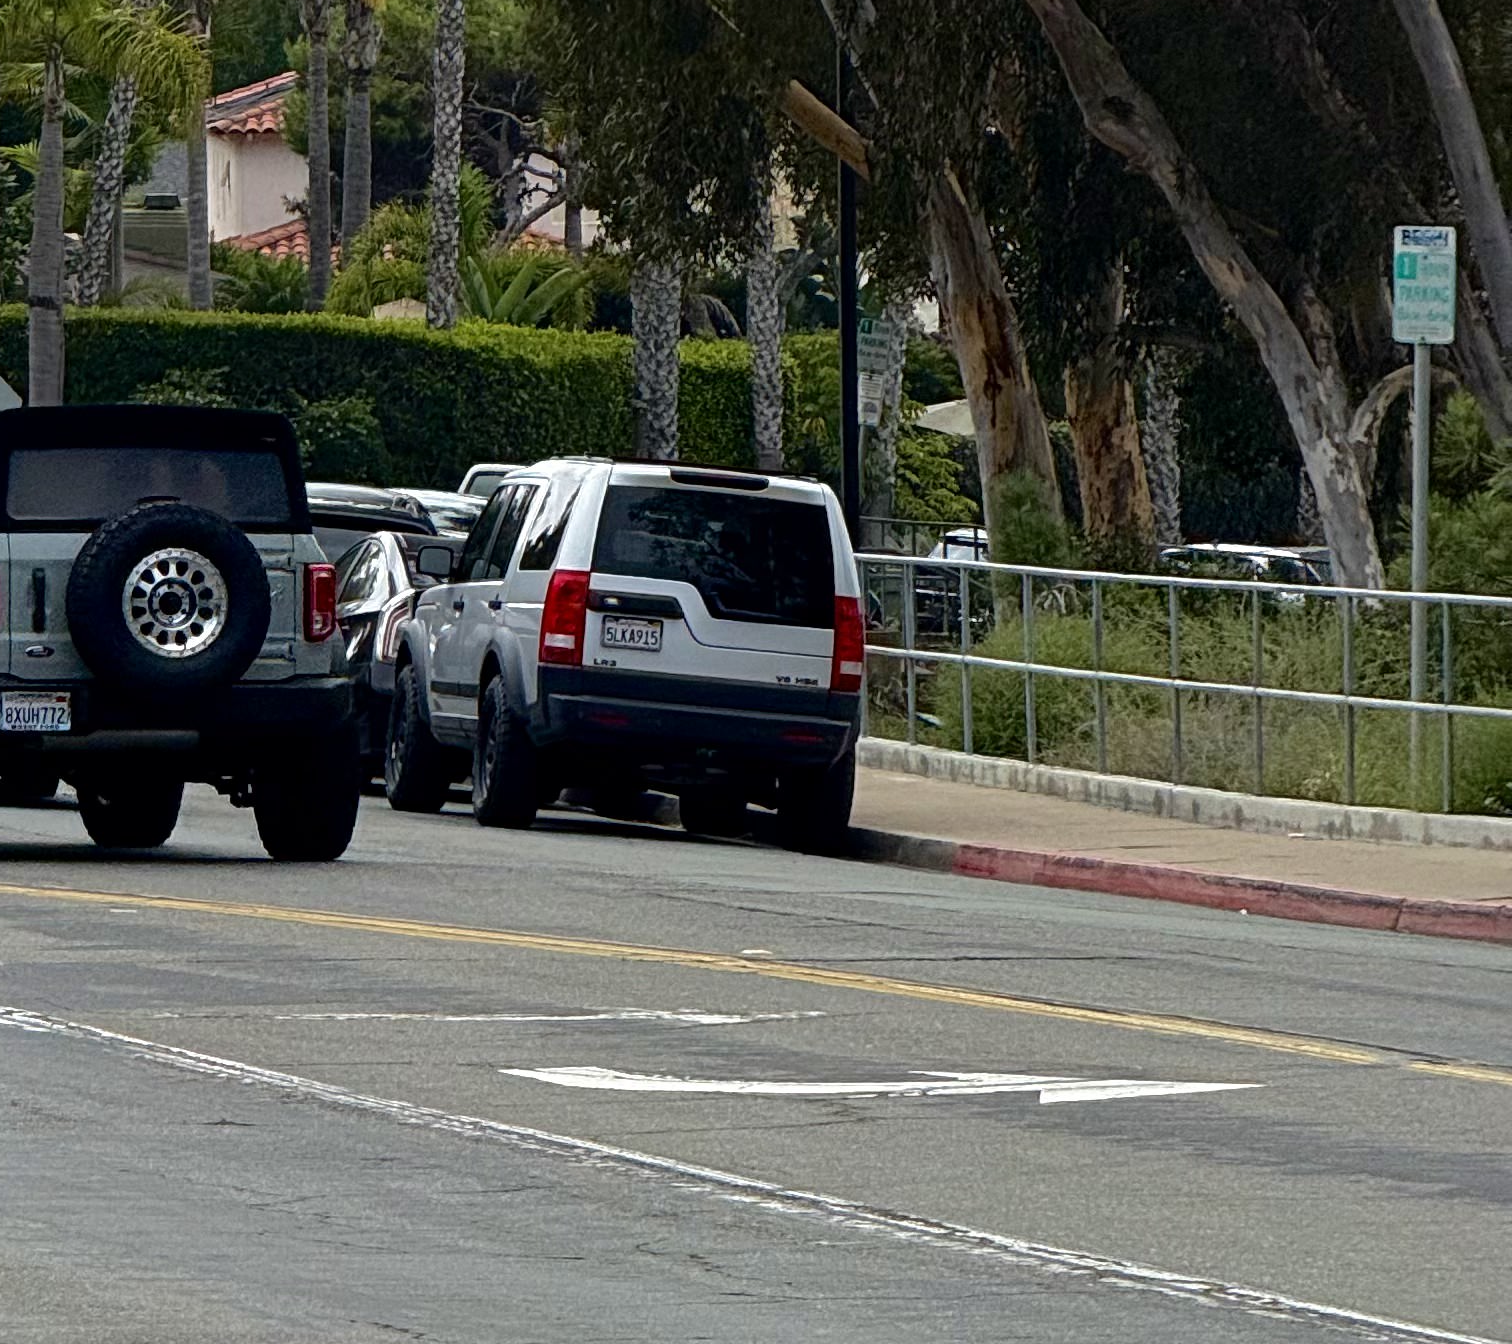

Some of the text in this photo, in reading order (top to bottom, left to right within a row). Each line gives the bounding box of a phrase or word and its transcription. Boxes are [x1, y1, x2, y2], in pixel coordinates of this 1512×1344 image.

[1399, 285, 1449, 303] PARKING
[606, 627, 658, 646] 5LKA915
[593, 658, 617, 667] LR3
[5, 706, 67, 725] 8XUH772
